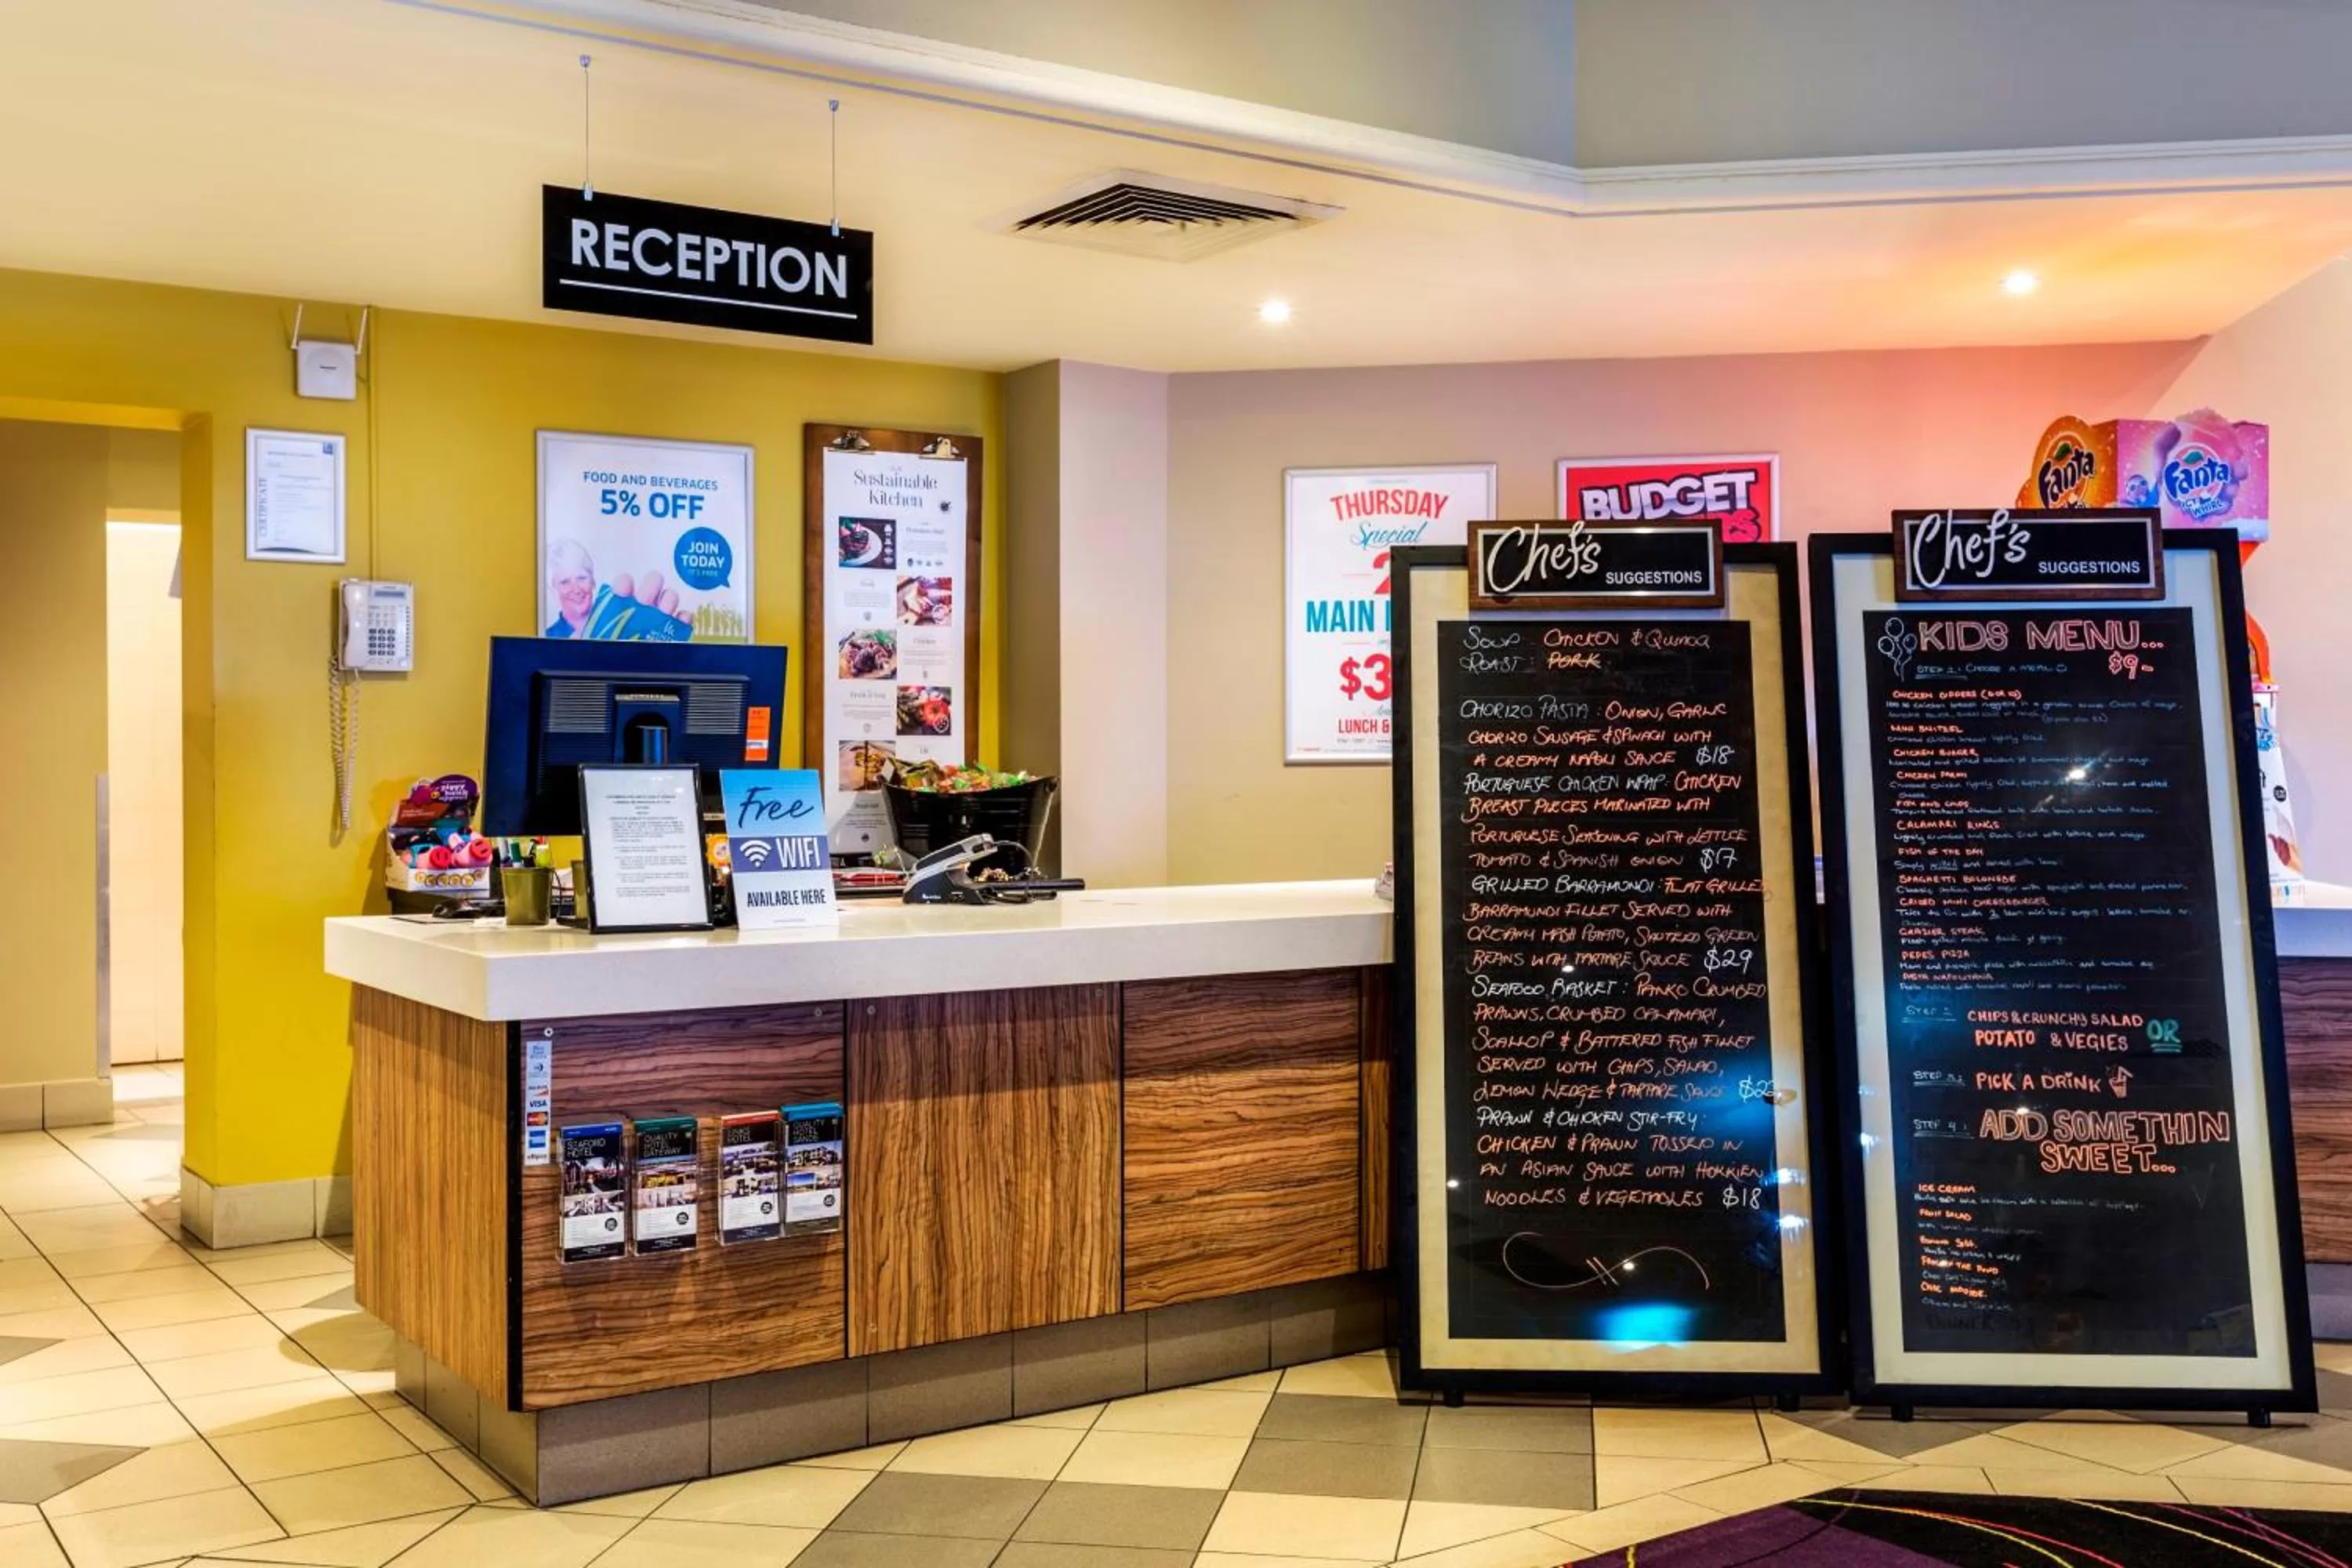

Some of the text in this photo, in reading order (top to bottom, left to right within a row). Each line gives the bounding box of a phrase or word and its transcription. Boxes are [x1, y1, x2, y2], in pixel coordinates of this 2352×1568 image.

[571, 217, 848, 299] RECEPTION
[583, 471, 718, 491] FOOD AND BEVERAGES
[854, 470, 939, 490] Sustainable
[2038, 448, 2095, 510] Fanta
[2164, 458, 2230, 500] Fanta
[601, 489, 704, 520] 5% OFF
[869, 490, 924, 509] Kitchen
[1330, 489, 1449, 521] THURSDAY
[1581, 470, 1757, 521] BUDGET
[1350, 521, 1428, 550] Special
[688, 541, 719, 554] JOIN
[1486, 521, 1602, 593] Chef's
[1913, 509, 2031, 589] Chef's
[681, 554, 726, 569] TODAY
[2038, 560, 2140, 575] SUGGESTIONS
[1606, 571, 1703, 585] SUGGESTIONS
[1306, 600, 1374, 633] MAIN
[1918, 620, 2009, 652] KIDS
[1547, 652, 1602, 670] PORK
[1893, 690, 1933, 699] CHICKEN
[1461, 700, 1533, 720] CHORIZO
[1537, 695, 1590, 719] PASTA
[1338, 719, 1377, 734] LUNCH
[1468, 725, 1712, 746] CHORIZO SAUSAGE WITH
[1473, 755, 1486, 768] A
[1494, 755, 1559, 768] CREAMY
[1624, 750, 1677, 767] SAUCE
[1695, 745, 1736, 766] $18
[1463, 772, 1551, 795] PORTUGUESE
[1557, 775, 1620, 793] CHICKEN
[1674, 771, 1742, 793] CHICKEN
[1896, 771, 1936, 779] CHICKEN
[738, 786, 814, 829] Free
[1461, 797, 1711, 823] BREAST PIECES MARINATED WITH
[1468, 822, 1561, 844] PORTUGUESE
[1646, 829, 1685, 844] WITH
[1686, 828, 1750, 844] LETTUCE
[1896, 819, 2000, 830] CALAMARI RINGS
[775, 837, 821, 869] WIFI
[1468, 851, 1532, 867] TOMATO
[1556, 848, 1620, 871] SPANISH
[1699, 847, 1738, 873] $17
[1965, 848, 1984, 856] DAY
[1471, 875, 1549, 895] GRILLED
[1899, 874, 1956, 884] SPAGHETTI
[747, 888, 827, 908] AVAILABLE HERE
[1462, 901, 1733, 922] BARRAMUNDI FILLET SERVED WITH
[1467, 925, 1535, 942] CREAMY
[1541, 927, 1577, 941] MASH
[1703, 926, 1760, 943] GREEN
[1467, 944, 1753, 974] BEANS WITH TARTARE SAUCE $29
[1901, 949, 1970, 960] PEPES PIZZA
[1471, 975, 1545, 998] SEAFOOD
[1635, 972, 1690, 1000] PANKO
[1693, 976, 1767, 1000] CRUMBED
[1546, 1004, 1626, 1025] CRUMBED
[1967, 1009, 2143, 1028] CHIPS SALAD
[1472, 1024, 1757, 1054] SCALLOP BATTERED FISH FILLET
[1974, 1029, 2129, 1052] POTATO & VEGIES
[2146, 1018, 2182, 1043] OR
[1475, 1056, 1546, 1074] SERVED
[1556, 1061, 1597, 1074] WITH
[1976, 1071, 2017, 1091] PICK
[2021, 1073, 2035, 1091] A
[1473, 1083, 1537, 1102] LEMON
[1542, 1079, 1605, 1108] WEDGE
[1619, 1083, 1682, 1099] TARTARE
[1475, 1105, 1533, 1127] PRAWN
[1979, 1108, 2231, 1144] ADD SOMETHIN
[567, 1138, 606, 1149] SEAFORD
[644, 1131, 678, 1142] QUALITY
[1477, 1134, 1744, 1155] CHICKEN PRAWN TOSSED IN
[567, 1147, 593, 1158] HOTEL
[644, 1147, 682, 1157] GATEWAY
[1479, 1163, 1508, 1177] AN
[1520, 1161, 1574, 1178] ASIAN
[1582, 1161, 1637, 1182] SAUCE
[1646, 1165, 1685, 1179] WITH
[1484, 1188, 1567, 1207] NOODLES
[1722, 1185, 1761, 1210] $18
[1918, 1184, 1976, 1193] ICE CREAM
